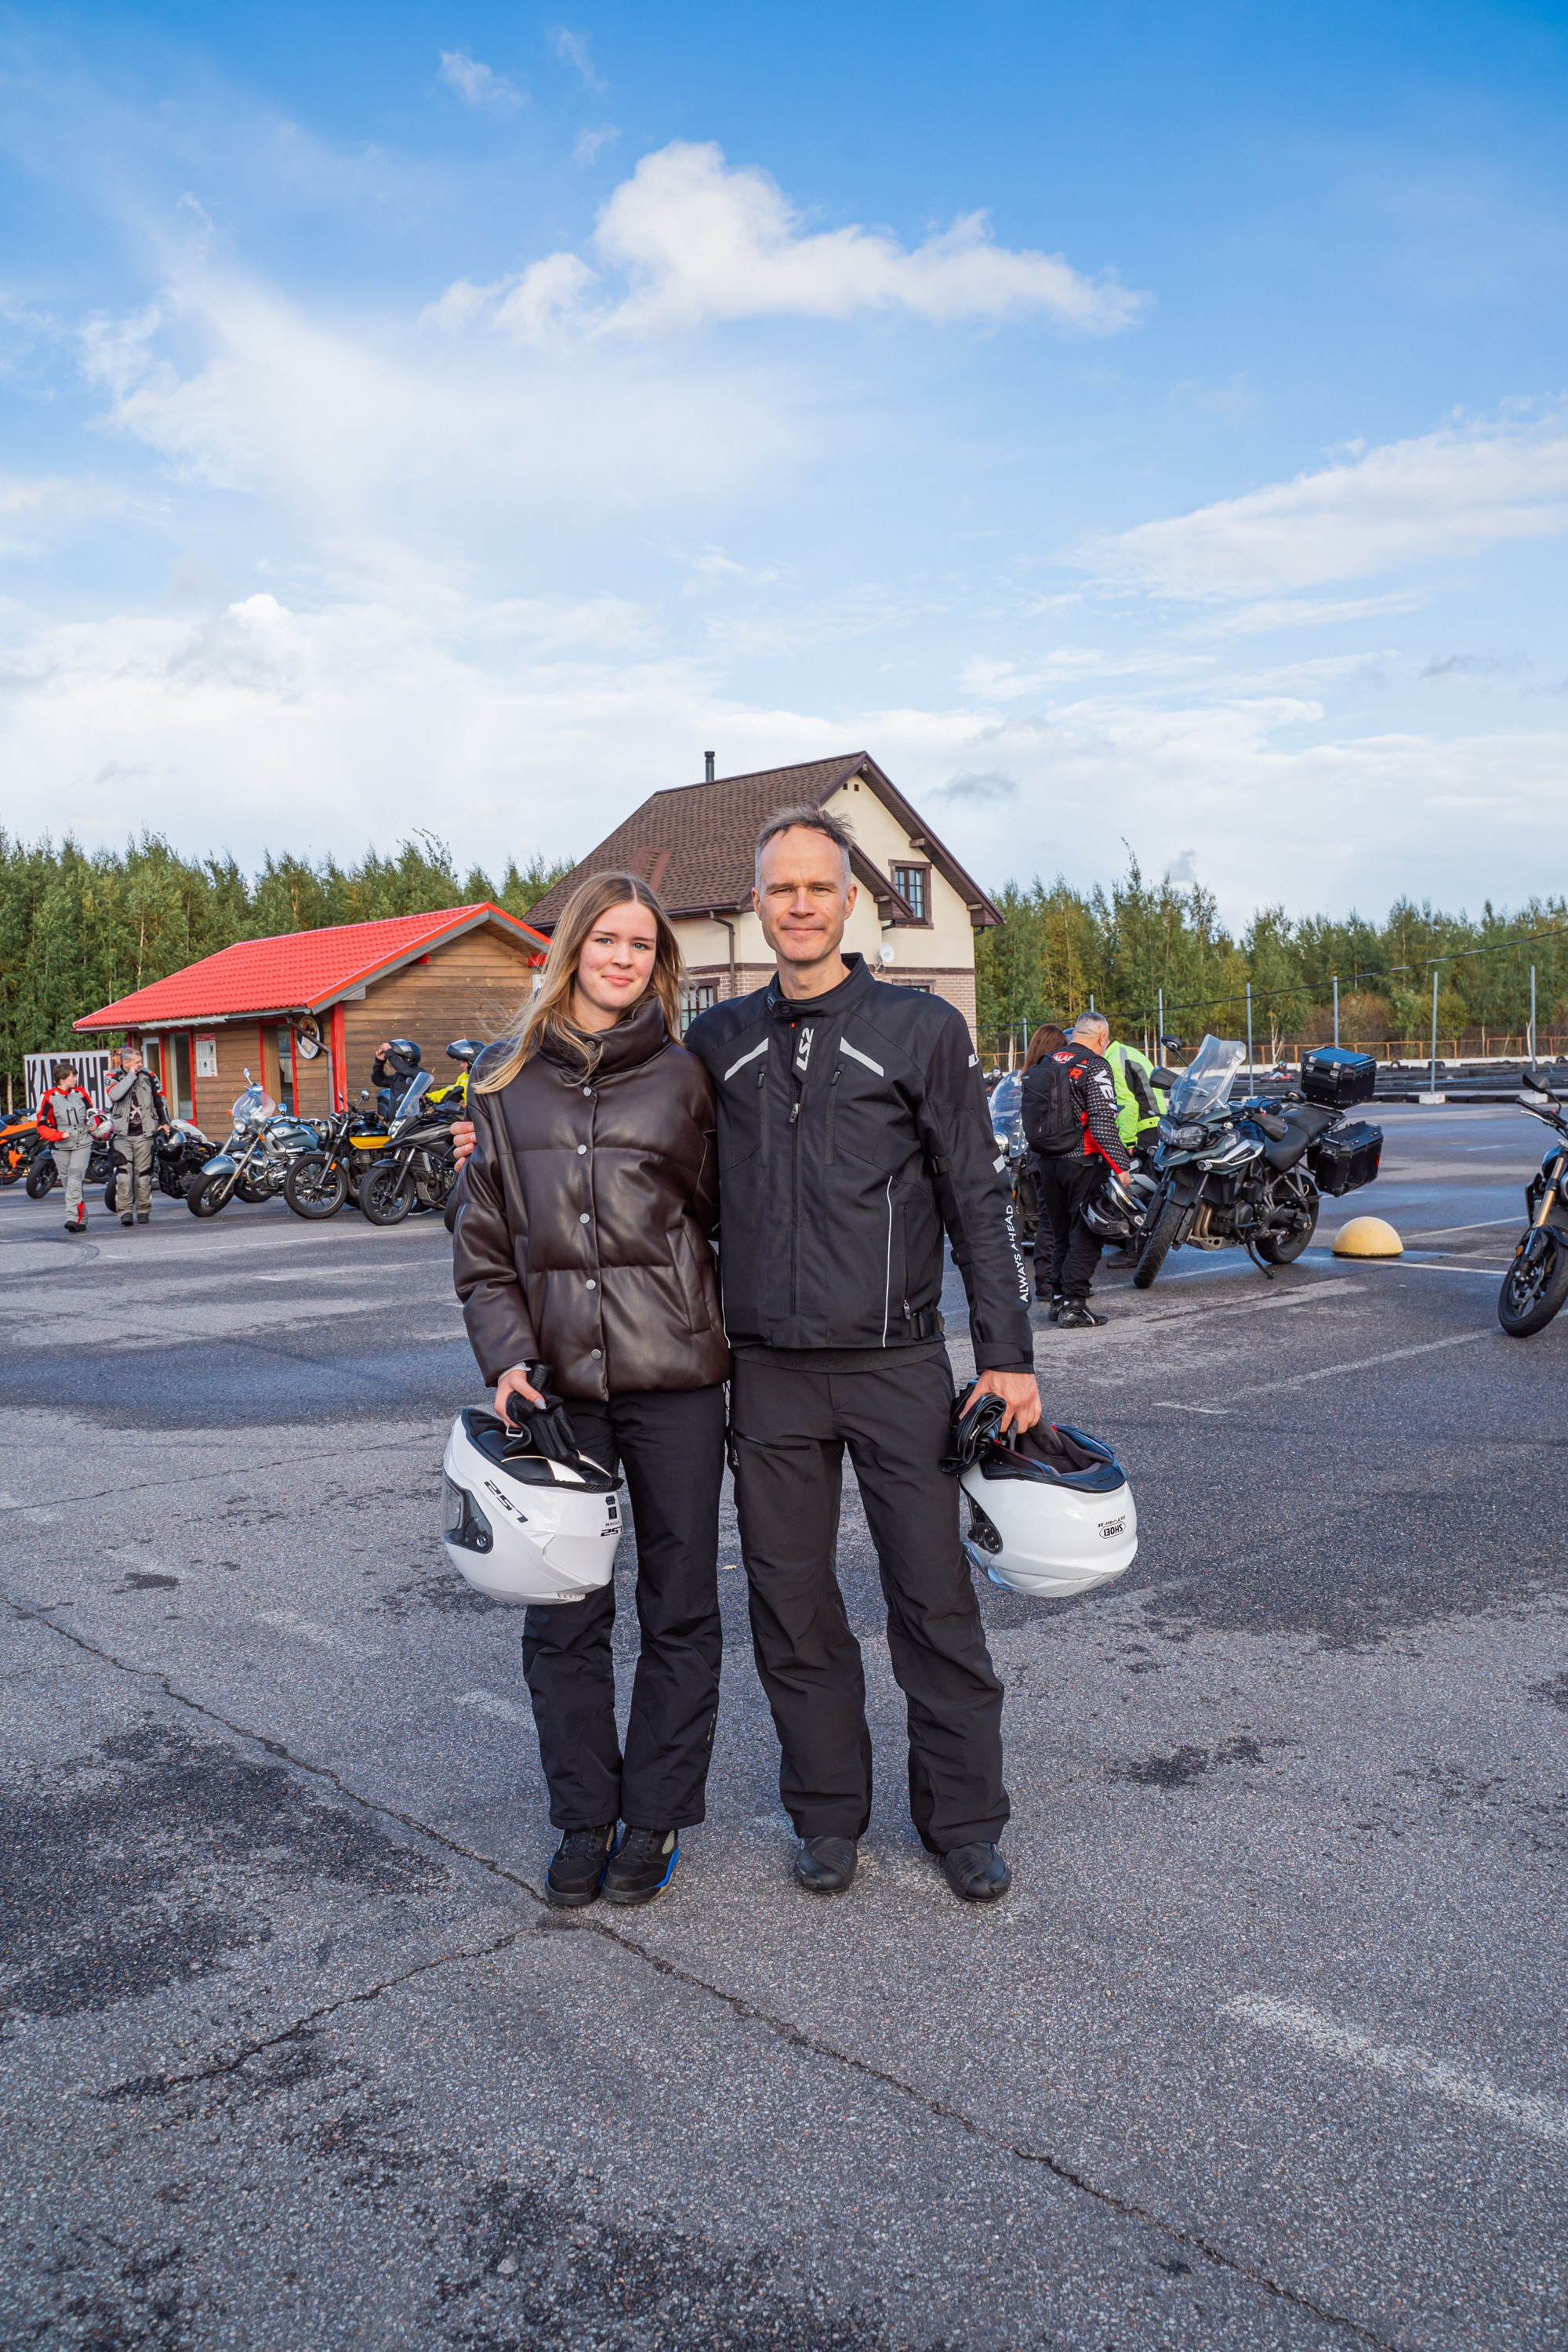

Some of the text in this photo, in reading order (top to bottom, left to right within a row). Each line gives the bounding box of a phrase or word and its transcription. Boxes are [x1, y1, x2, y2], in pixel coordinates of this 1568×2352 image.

[796, 1027, 814, 1071] LS2
[27, 1056, 109, 1110] КАНГ
[1004, 1205, 1029, 1302] ALWAYS AHEAD
[484, 1479, 528, 1523] LS2
[1103, 1523, 1123, 1537] SHOEI
